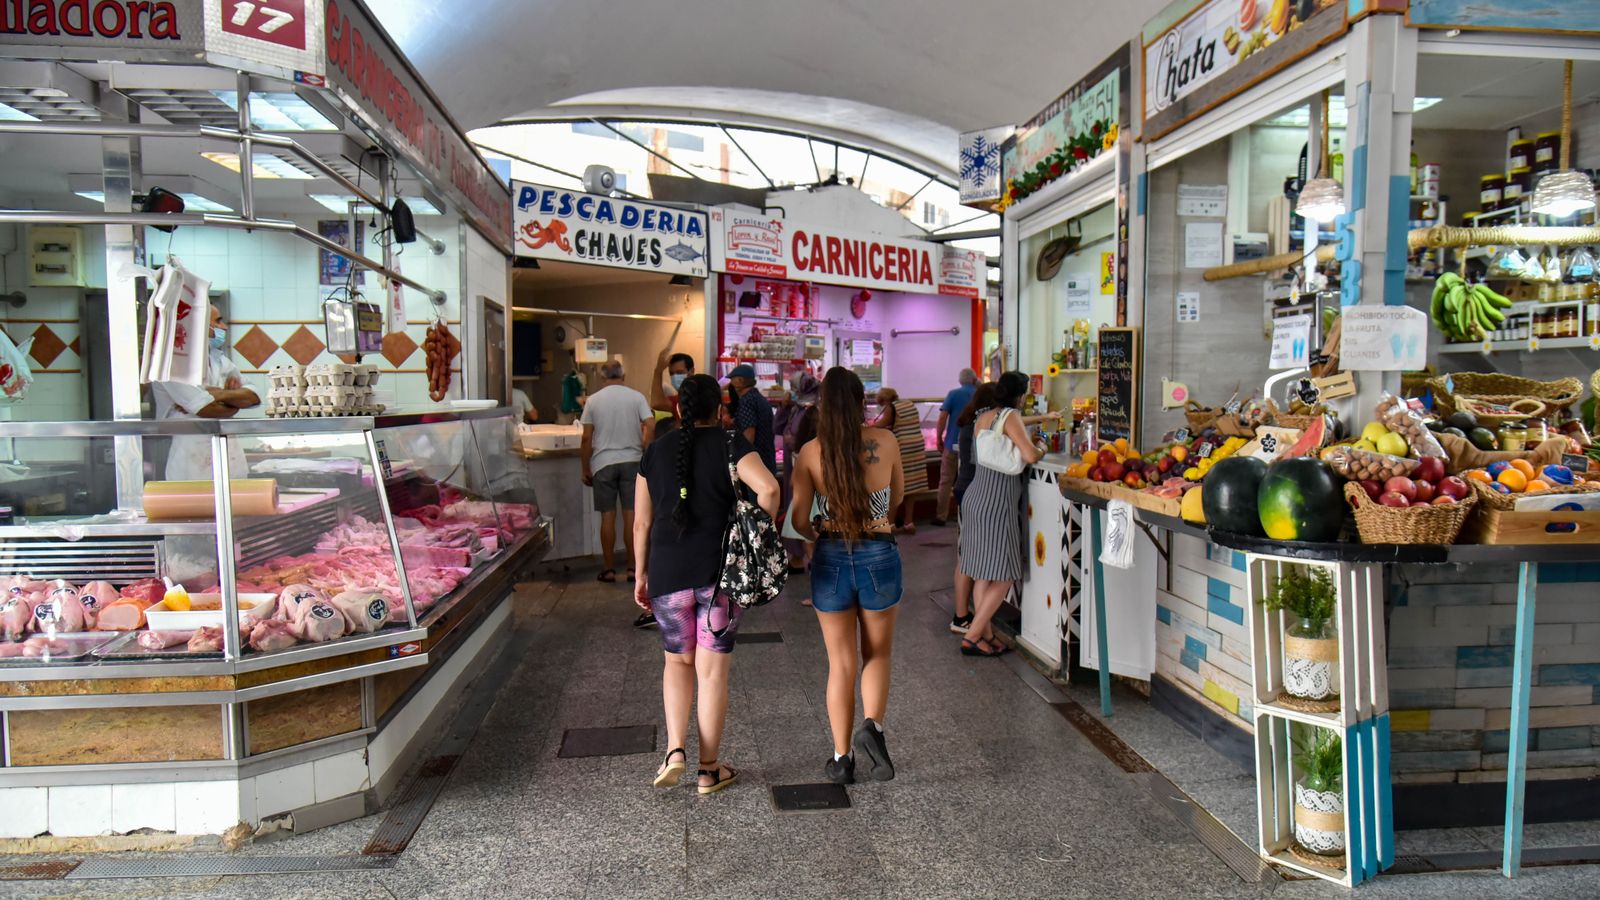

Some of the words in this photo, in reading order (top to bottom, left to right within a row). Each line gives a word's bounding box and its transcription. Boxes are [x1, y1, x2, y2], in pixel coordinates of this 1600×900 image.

[231, 1, 294, 33] 17
[1096, 79, 1115, 123] 54
[518, 186, 705, 238] PESCADERIA
[960, 188, 998, 201] CONGELADOS
[791, 230, 933, 286] CARNICERIA
